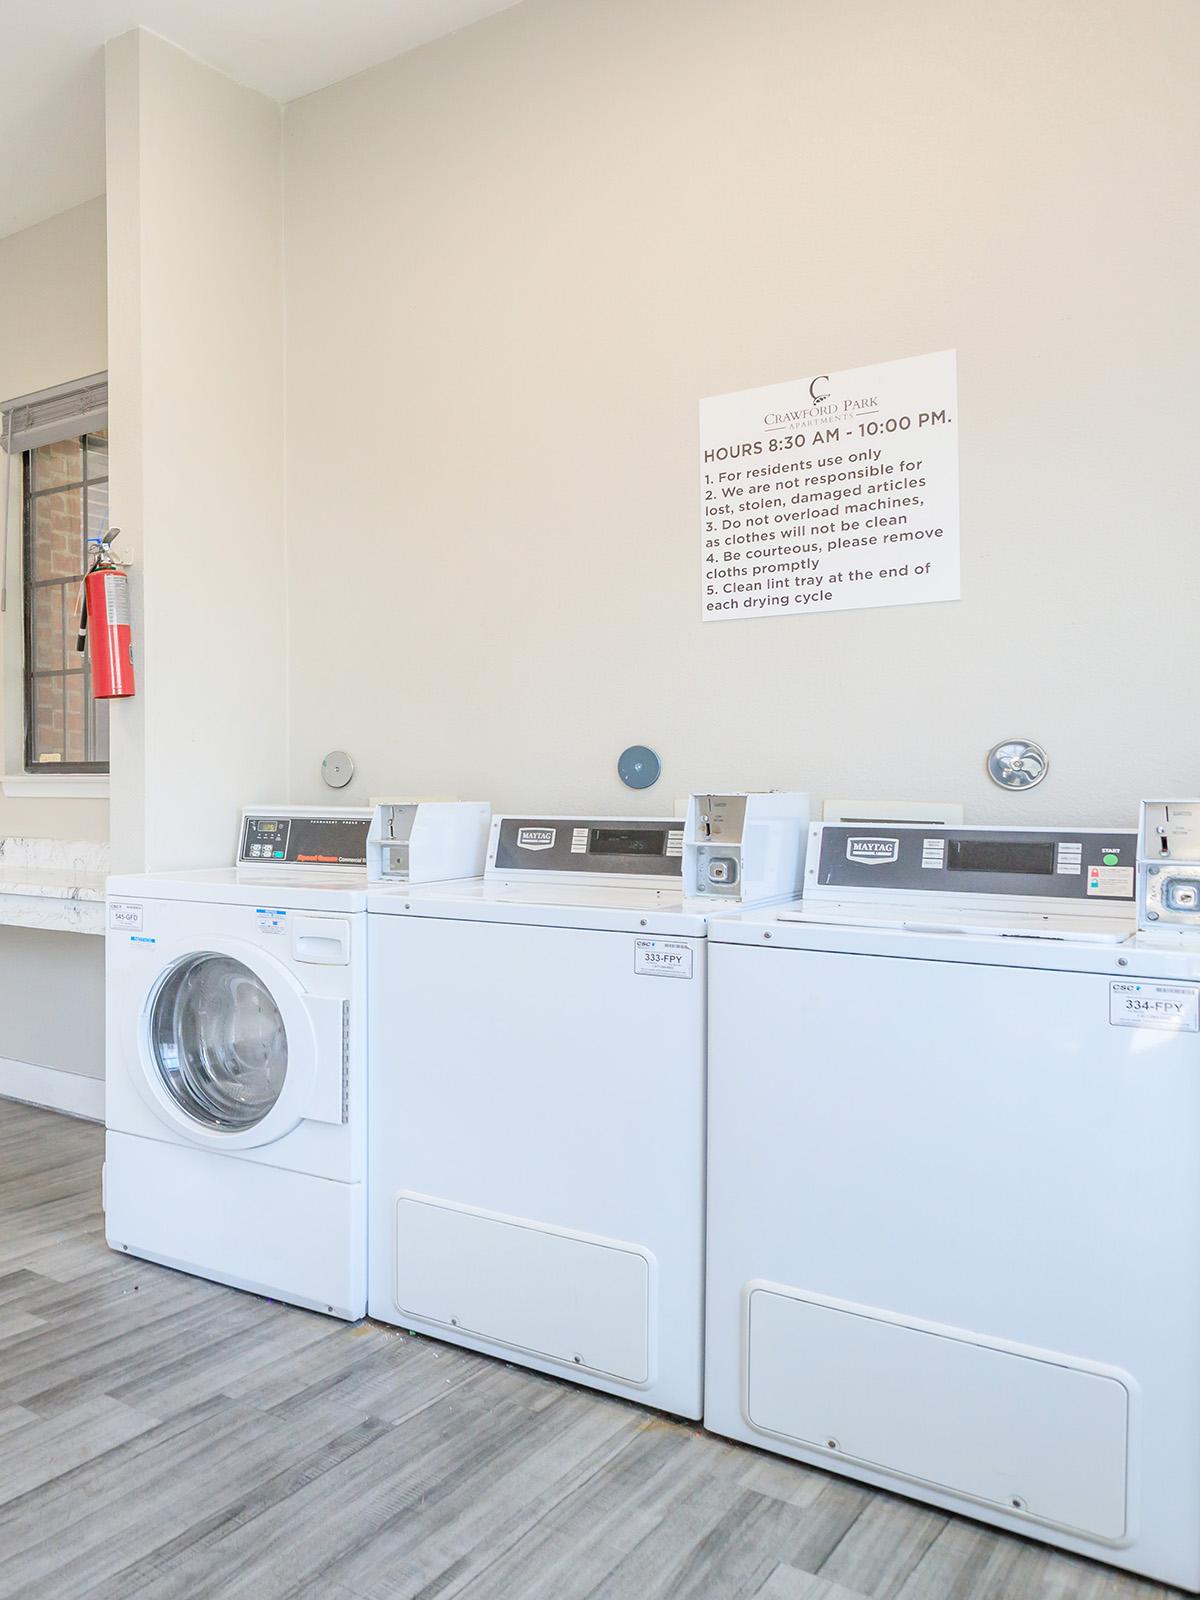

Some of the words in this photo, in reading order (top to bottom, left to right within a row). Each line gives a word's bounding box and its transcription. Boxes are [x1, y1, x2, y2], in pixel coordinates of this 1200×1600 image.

[764, 403, 838, 425] CRAWFORD
[844, 396, 879, 412] PARK
[789, 413, 853, 430] APARTMENTS
[704, 441, 763, 463] HOURS
[769, 434, 805, 452] 8:30
[812, 428, 839, 445] AM
[858, 416, 911, 437] 10:00
[919, 410, 951, 428] PM.
[705, 475, 714, 485] 1.
[719, 472, 742, 483] For
[746, 460, 812, 478] residents
[818, 456, 843, 467] use
[848, 448, 882, 463] only
[705, 490, 717, 500] 2.
[721, 486, 744, 498] We
[748, 484, 770, 494] are
[776, 477, 799, 490] not
[805, 464, 894, 486] responsible
[899, 460, 923, 472] for
[706, 504, 734, 516] lost,
[739, 498, 786, 512] stolen,
[791, 484, 861, 504] damaged
[867, 477, 926, 494] articles
[706, 522, 717, 532] 3.
[722, 519, 741, 530] Do
[746, 515, 769, 527] not
[774, 504, 839, 523] overload
[845, 496, 924, 514] machines,
[706, 539, 720, 548] as
[724, 532, 775, 546] clothes
[780, 525, 805, 539] will
[811, 522, 835, 535] not
[841, 520, 860, 531] be
[865, 515, 907, 528] clean
[706, 553, 718, 563] 4.
[724, 551, 741, 562] Be
[745, 543, 822, 559] courteous,
[828, 536, 877, 552] please
[883, 528, 943, 543] remove
[706, 566, 748, 579] cloths
[753, 558, 819, 577] promptly
[707, 585, 718, 595] 5.
[723, 582, 762, 593] Clean
[767, 578, 790, 589] lint
[795, 576, 823, 588] tray
[828, 572, 843, 583] at
[848, 569, 873, 581] the
[879, 564, 908, 578] end
[914, 562, 931, 575] of
[706, 598, 738, 611] each
[743, 595, 789, 608] drying
[794, 590, 833, 605] cycle
[522, 831, 552, 840] MAYTAG
[853, 842, 893, 852] MAYTAG
[645, 953, 682, 963] 333-FPY
[1126, 1000, 1183, 1012] 334-FPY
